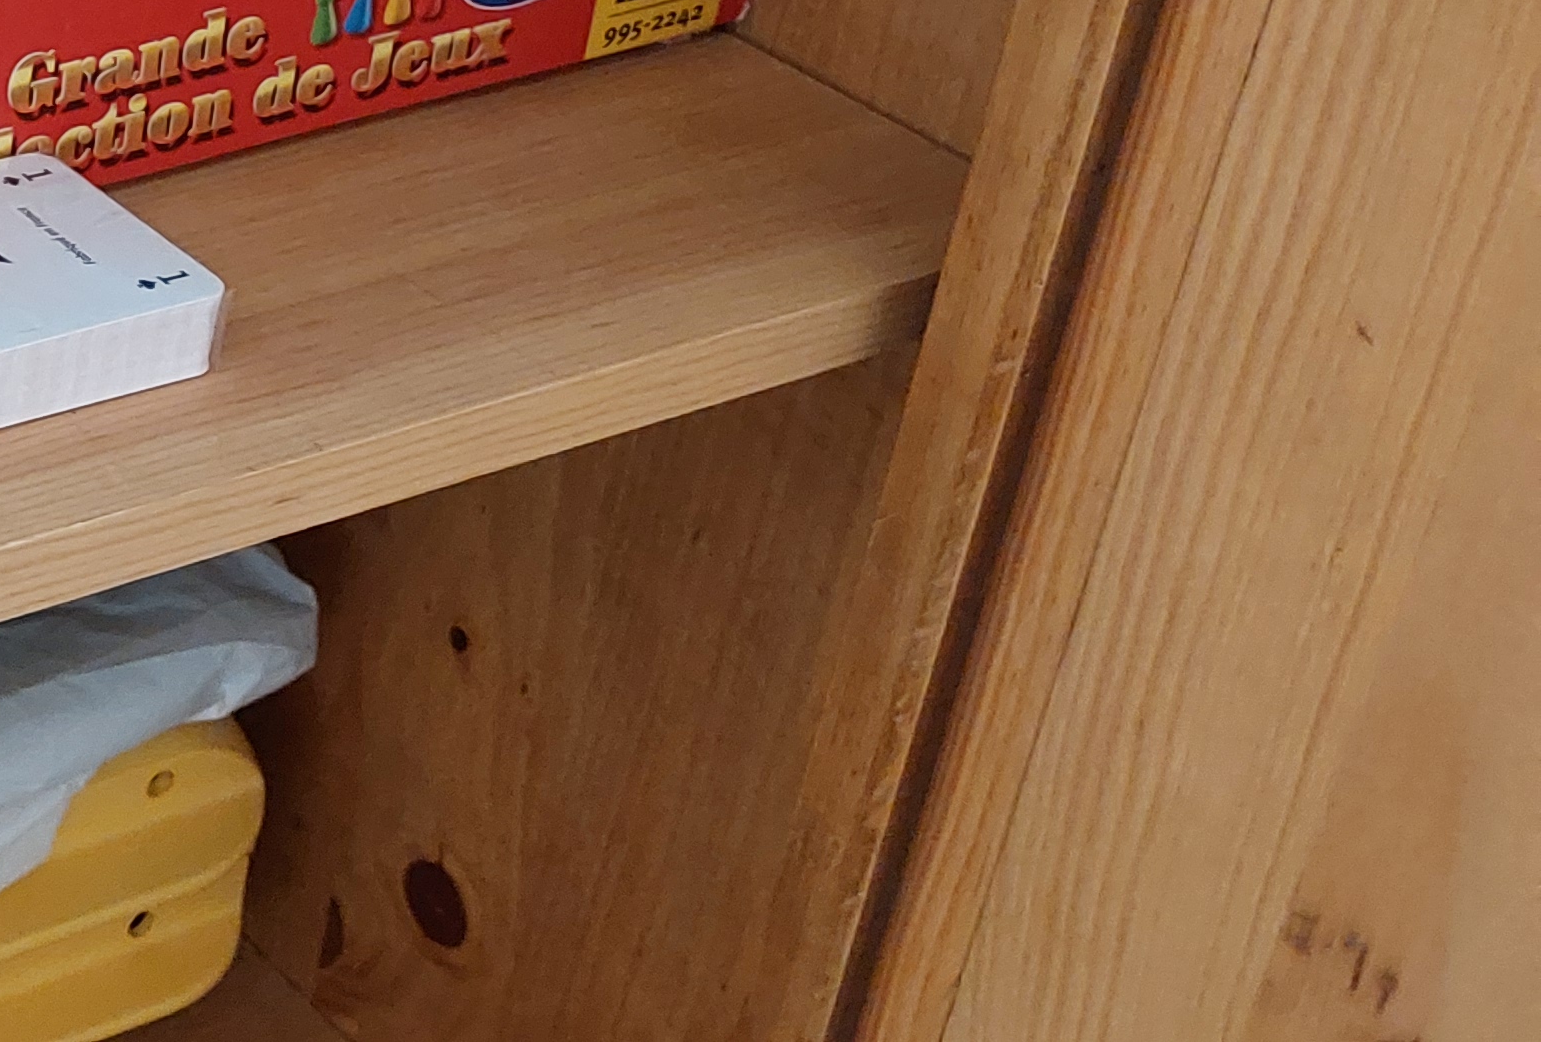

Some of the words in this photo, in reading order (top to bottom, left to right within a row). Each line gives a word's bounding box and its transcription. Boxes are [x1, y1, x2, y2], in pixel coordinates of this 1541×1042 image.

[7, 7, 269, 116] Grande
[252, 57, 335, 120] de
[350, 19, 514, 95] Jeux
[603, 4, 704, 49] 995-2242
